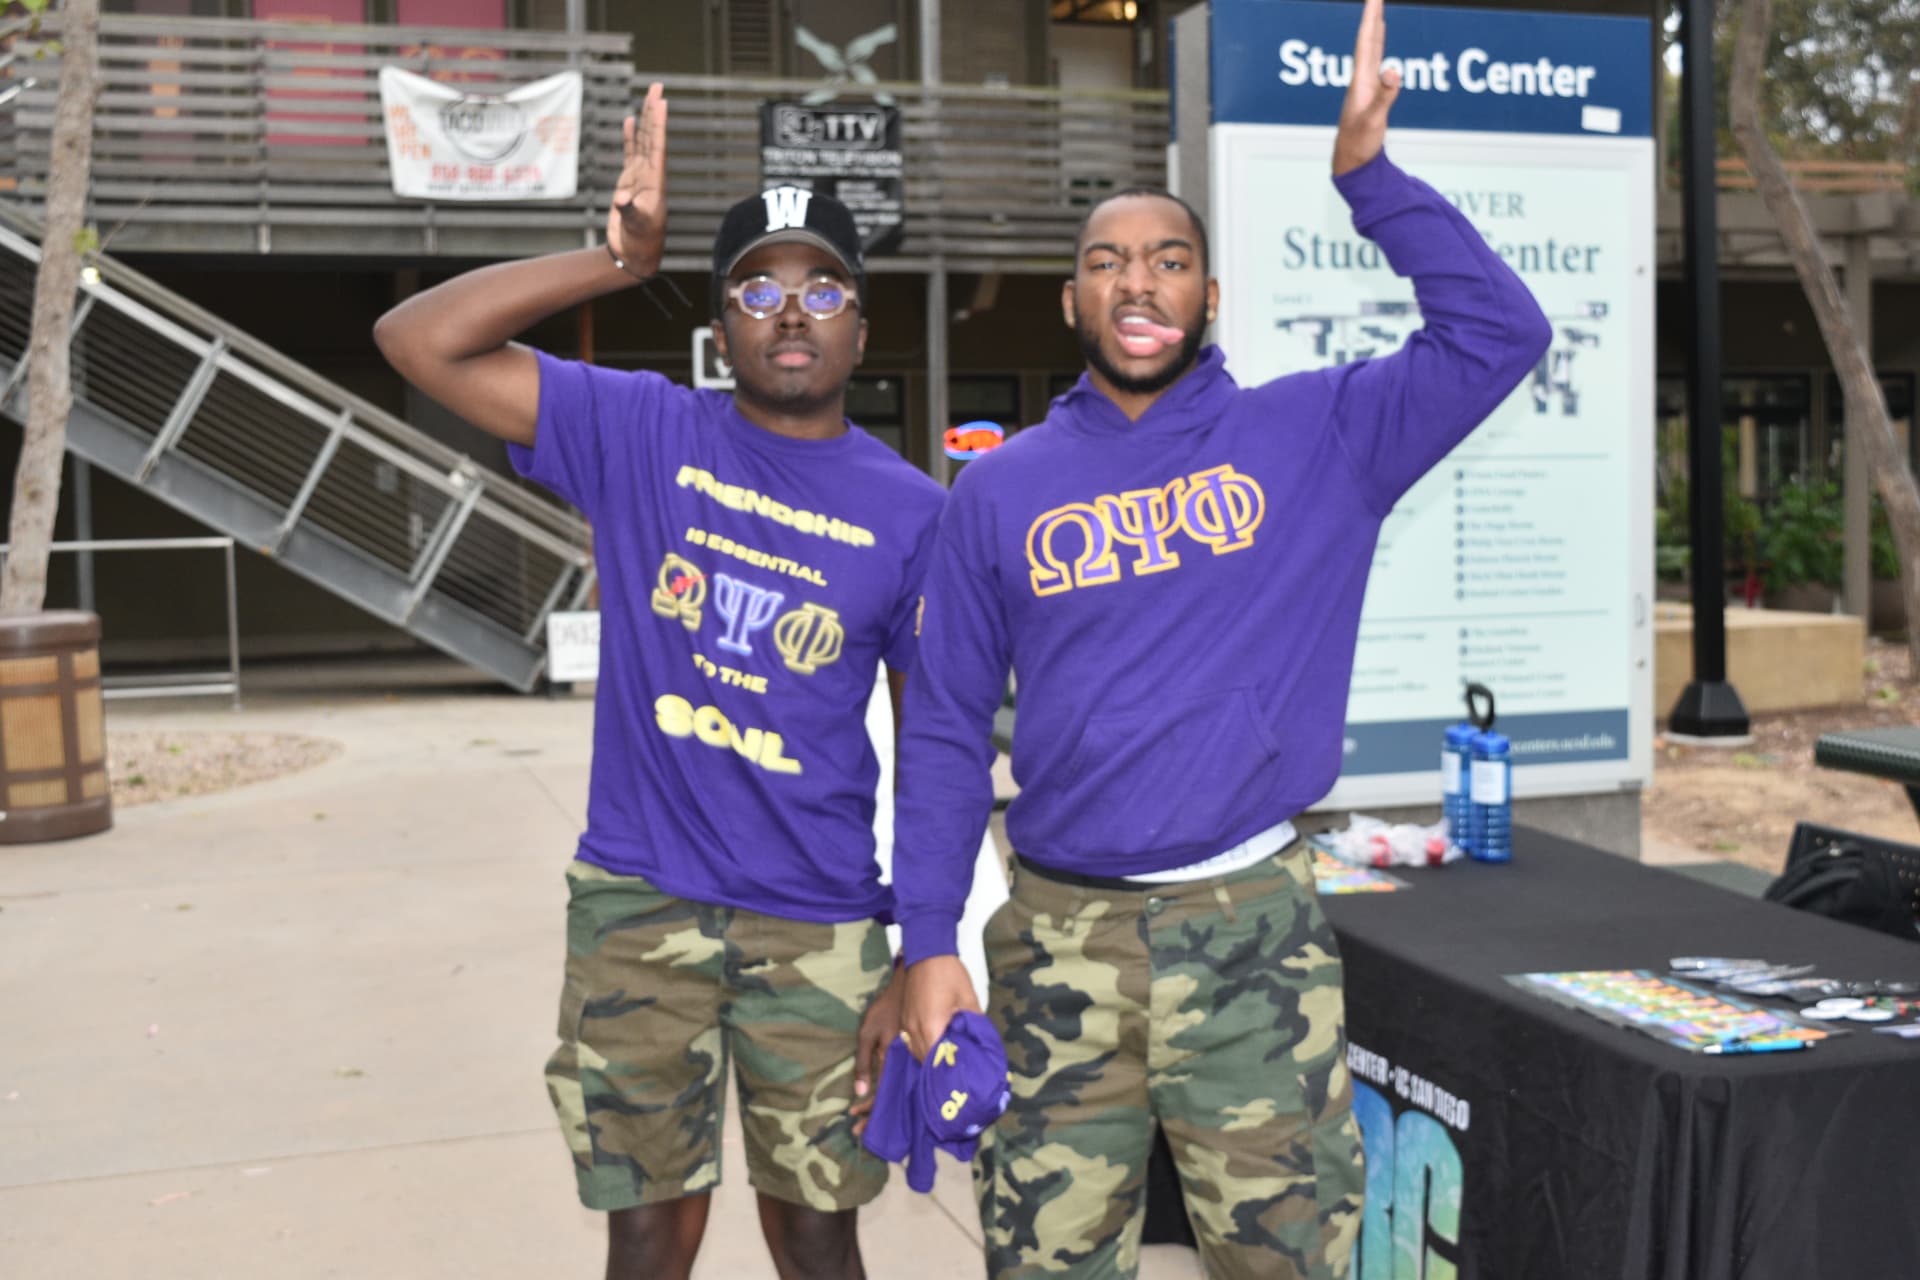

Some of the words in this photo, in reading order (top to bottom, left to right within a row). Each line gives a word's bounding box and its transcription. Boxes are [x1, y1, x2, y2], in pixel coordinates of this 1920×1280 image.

[1279, 40, 1449, 92] Stuent
[1457, 48, 1596, 98] Center
[761, 186, 813, 233] W
[1283, 226, 1381, 270] Stud
[1484, 231, 1601, 273] enter
[676, 464, 876, 548] FRIENDSHIP
[706, 533, 828, 587] ESSENTIAL
[719, 665, 768, 695] THE
[654, 694, 803, 775] SOUL
[1410, 1074, 1434, 1112] SAN
[1433, 1086, 1470, 1131] DIEGO
